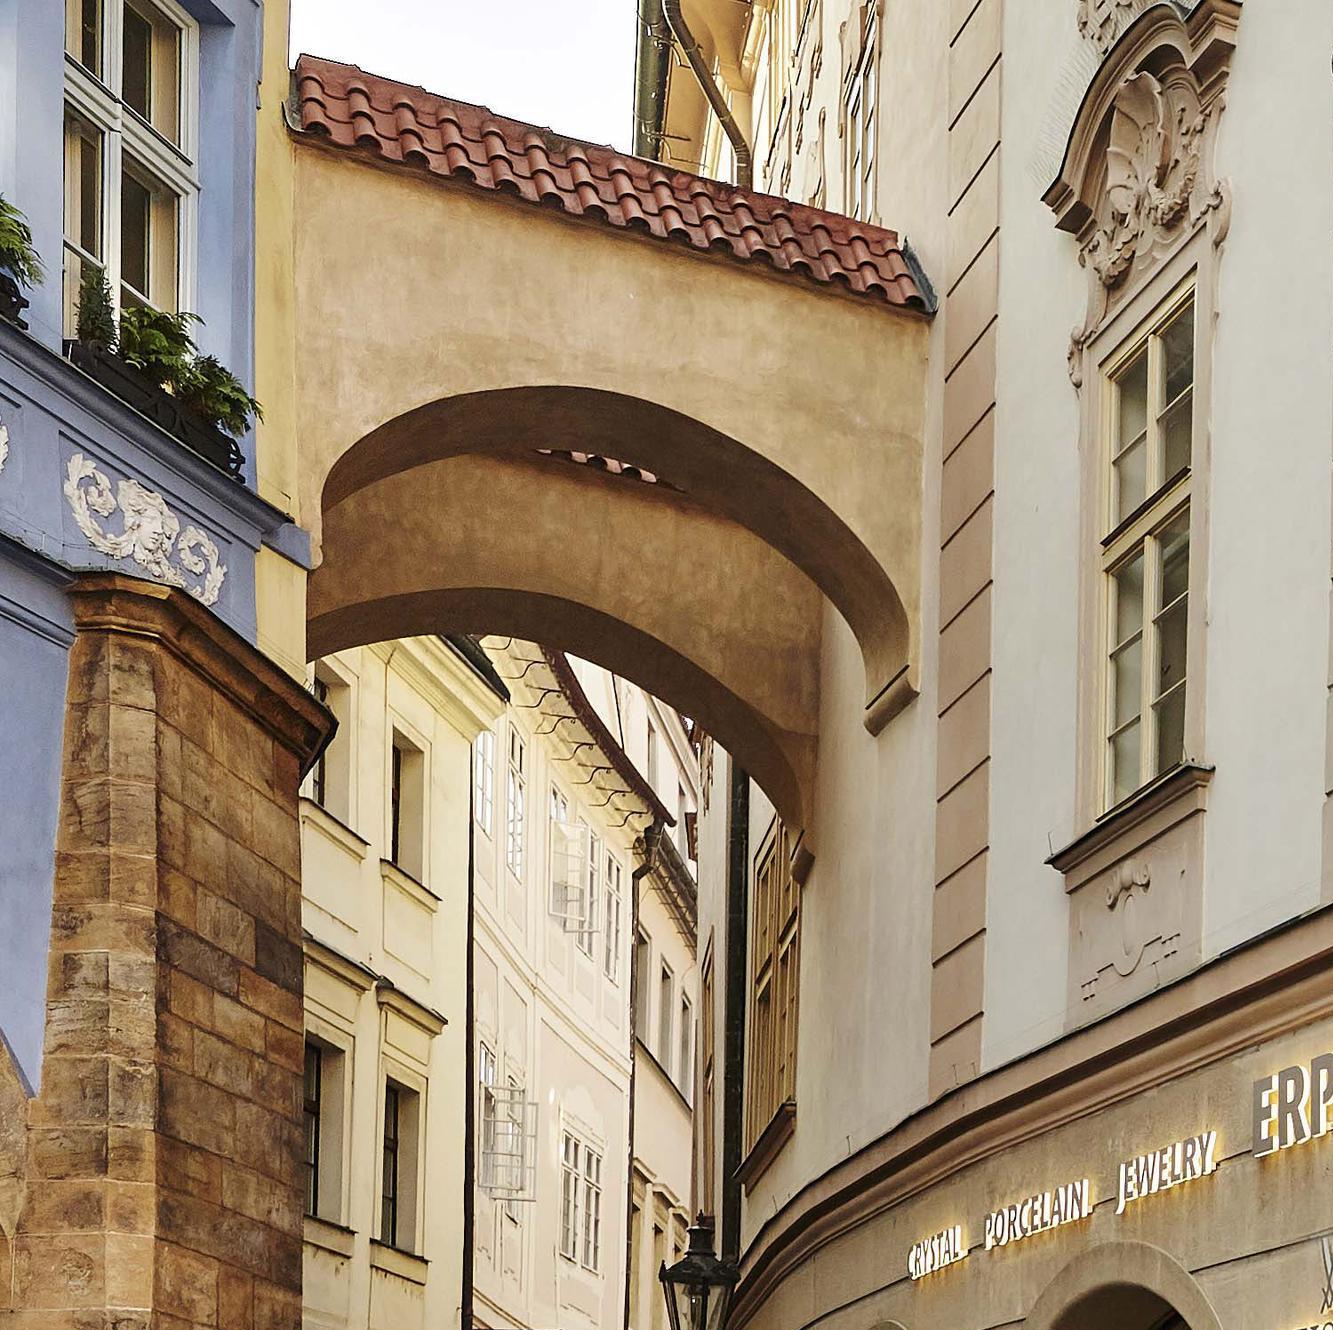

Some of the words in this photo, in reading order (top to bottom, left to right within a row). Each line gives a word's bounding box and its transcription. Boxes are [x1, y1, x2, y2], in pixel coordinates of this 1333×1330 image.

[908, 1225, 967, 1280] CRYSTAL
[984, 1179, 1092, 1251] PORCELAIN
[1115, 1130, 1217, 1215] JEWELRY
